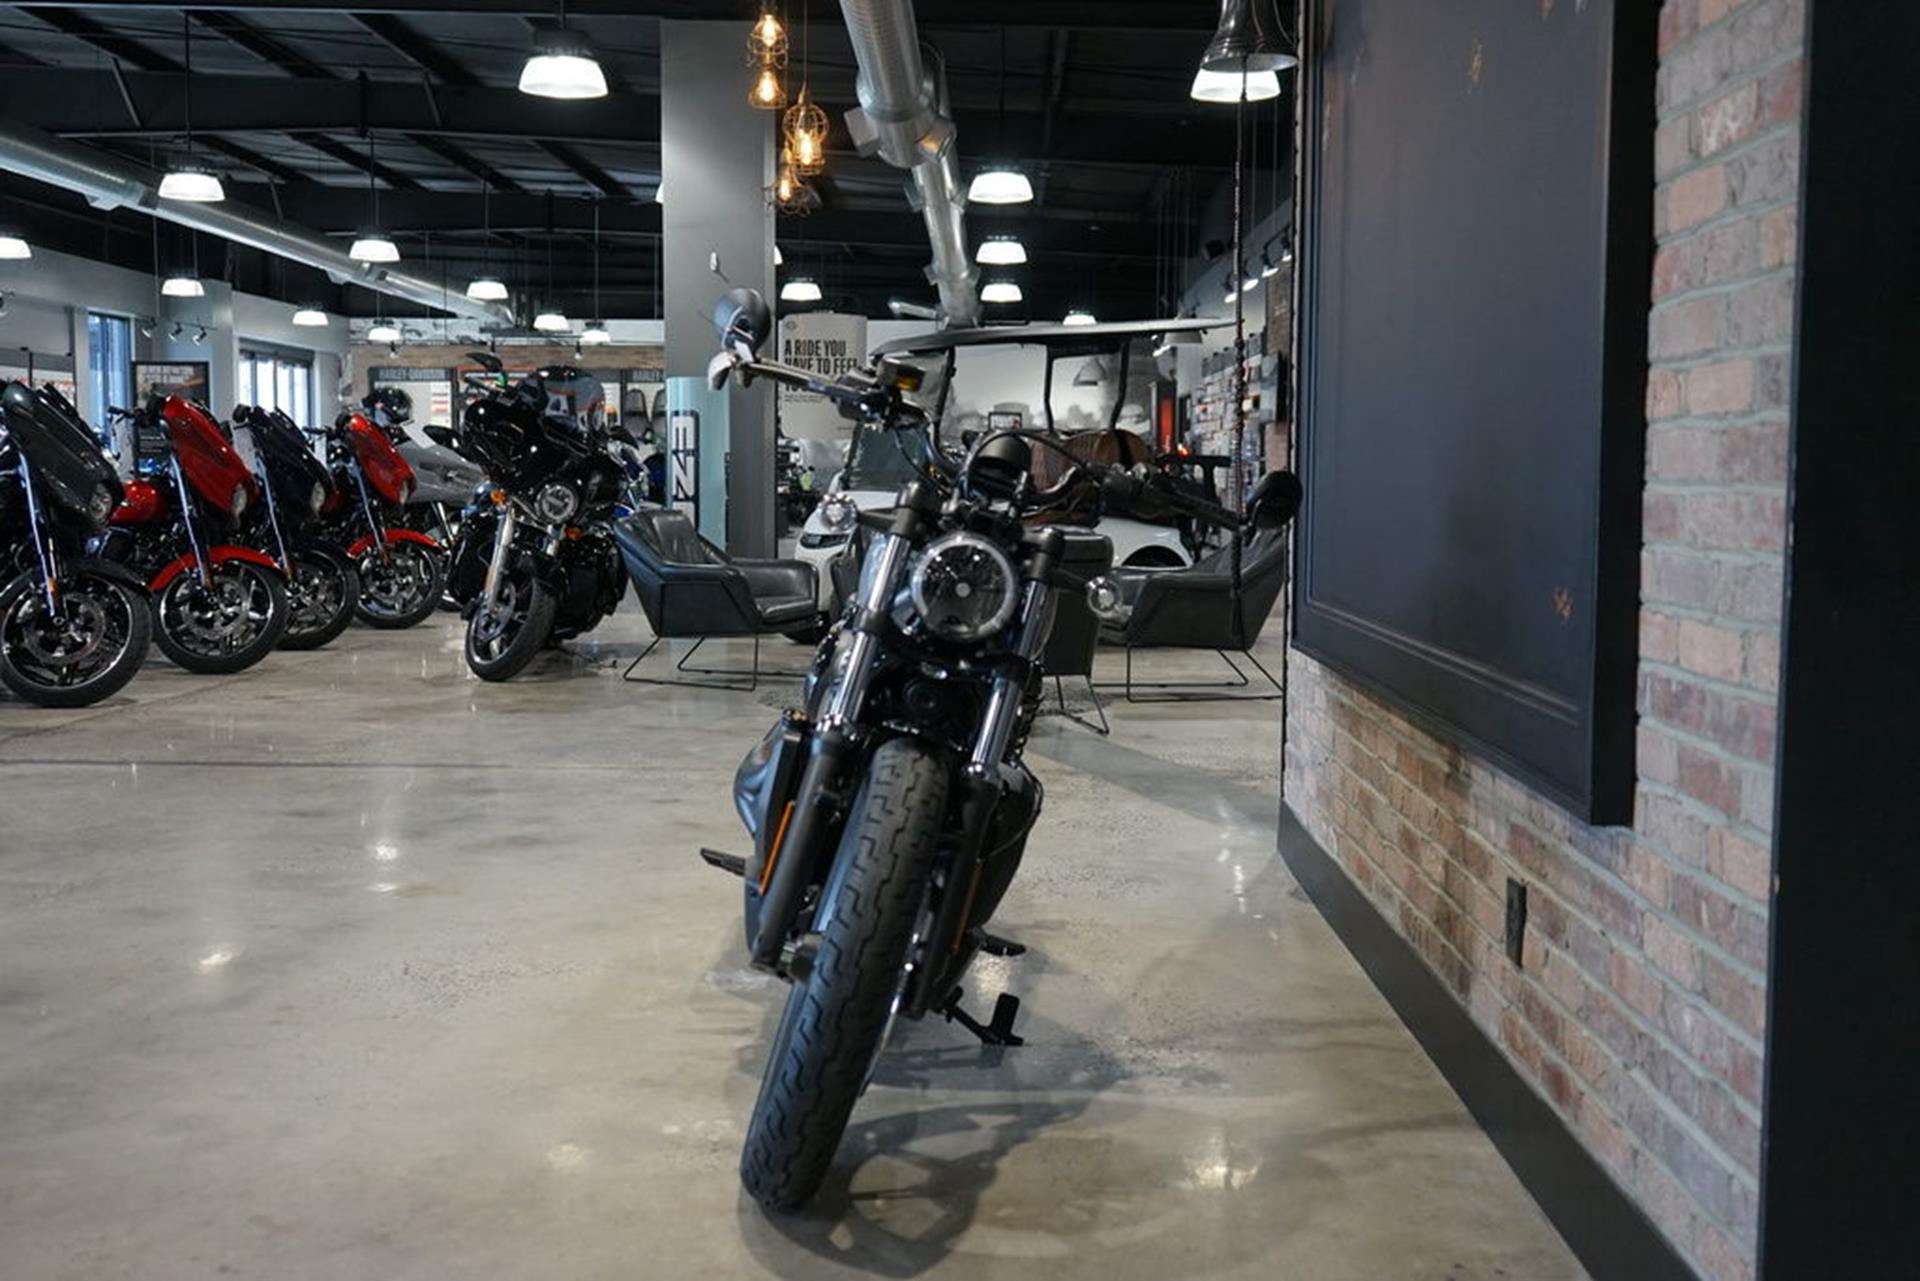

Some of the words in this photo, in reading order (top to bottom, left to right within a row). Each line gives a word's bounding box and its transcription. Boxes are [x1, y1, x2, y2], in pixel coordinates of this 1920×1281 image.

[784, 339, 792, 355] A
[794, 339, 822, 357] RIDE
[824, 340, 846, 357] YOU
[816, 358, 831, 375] TO
